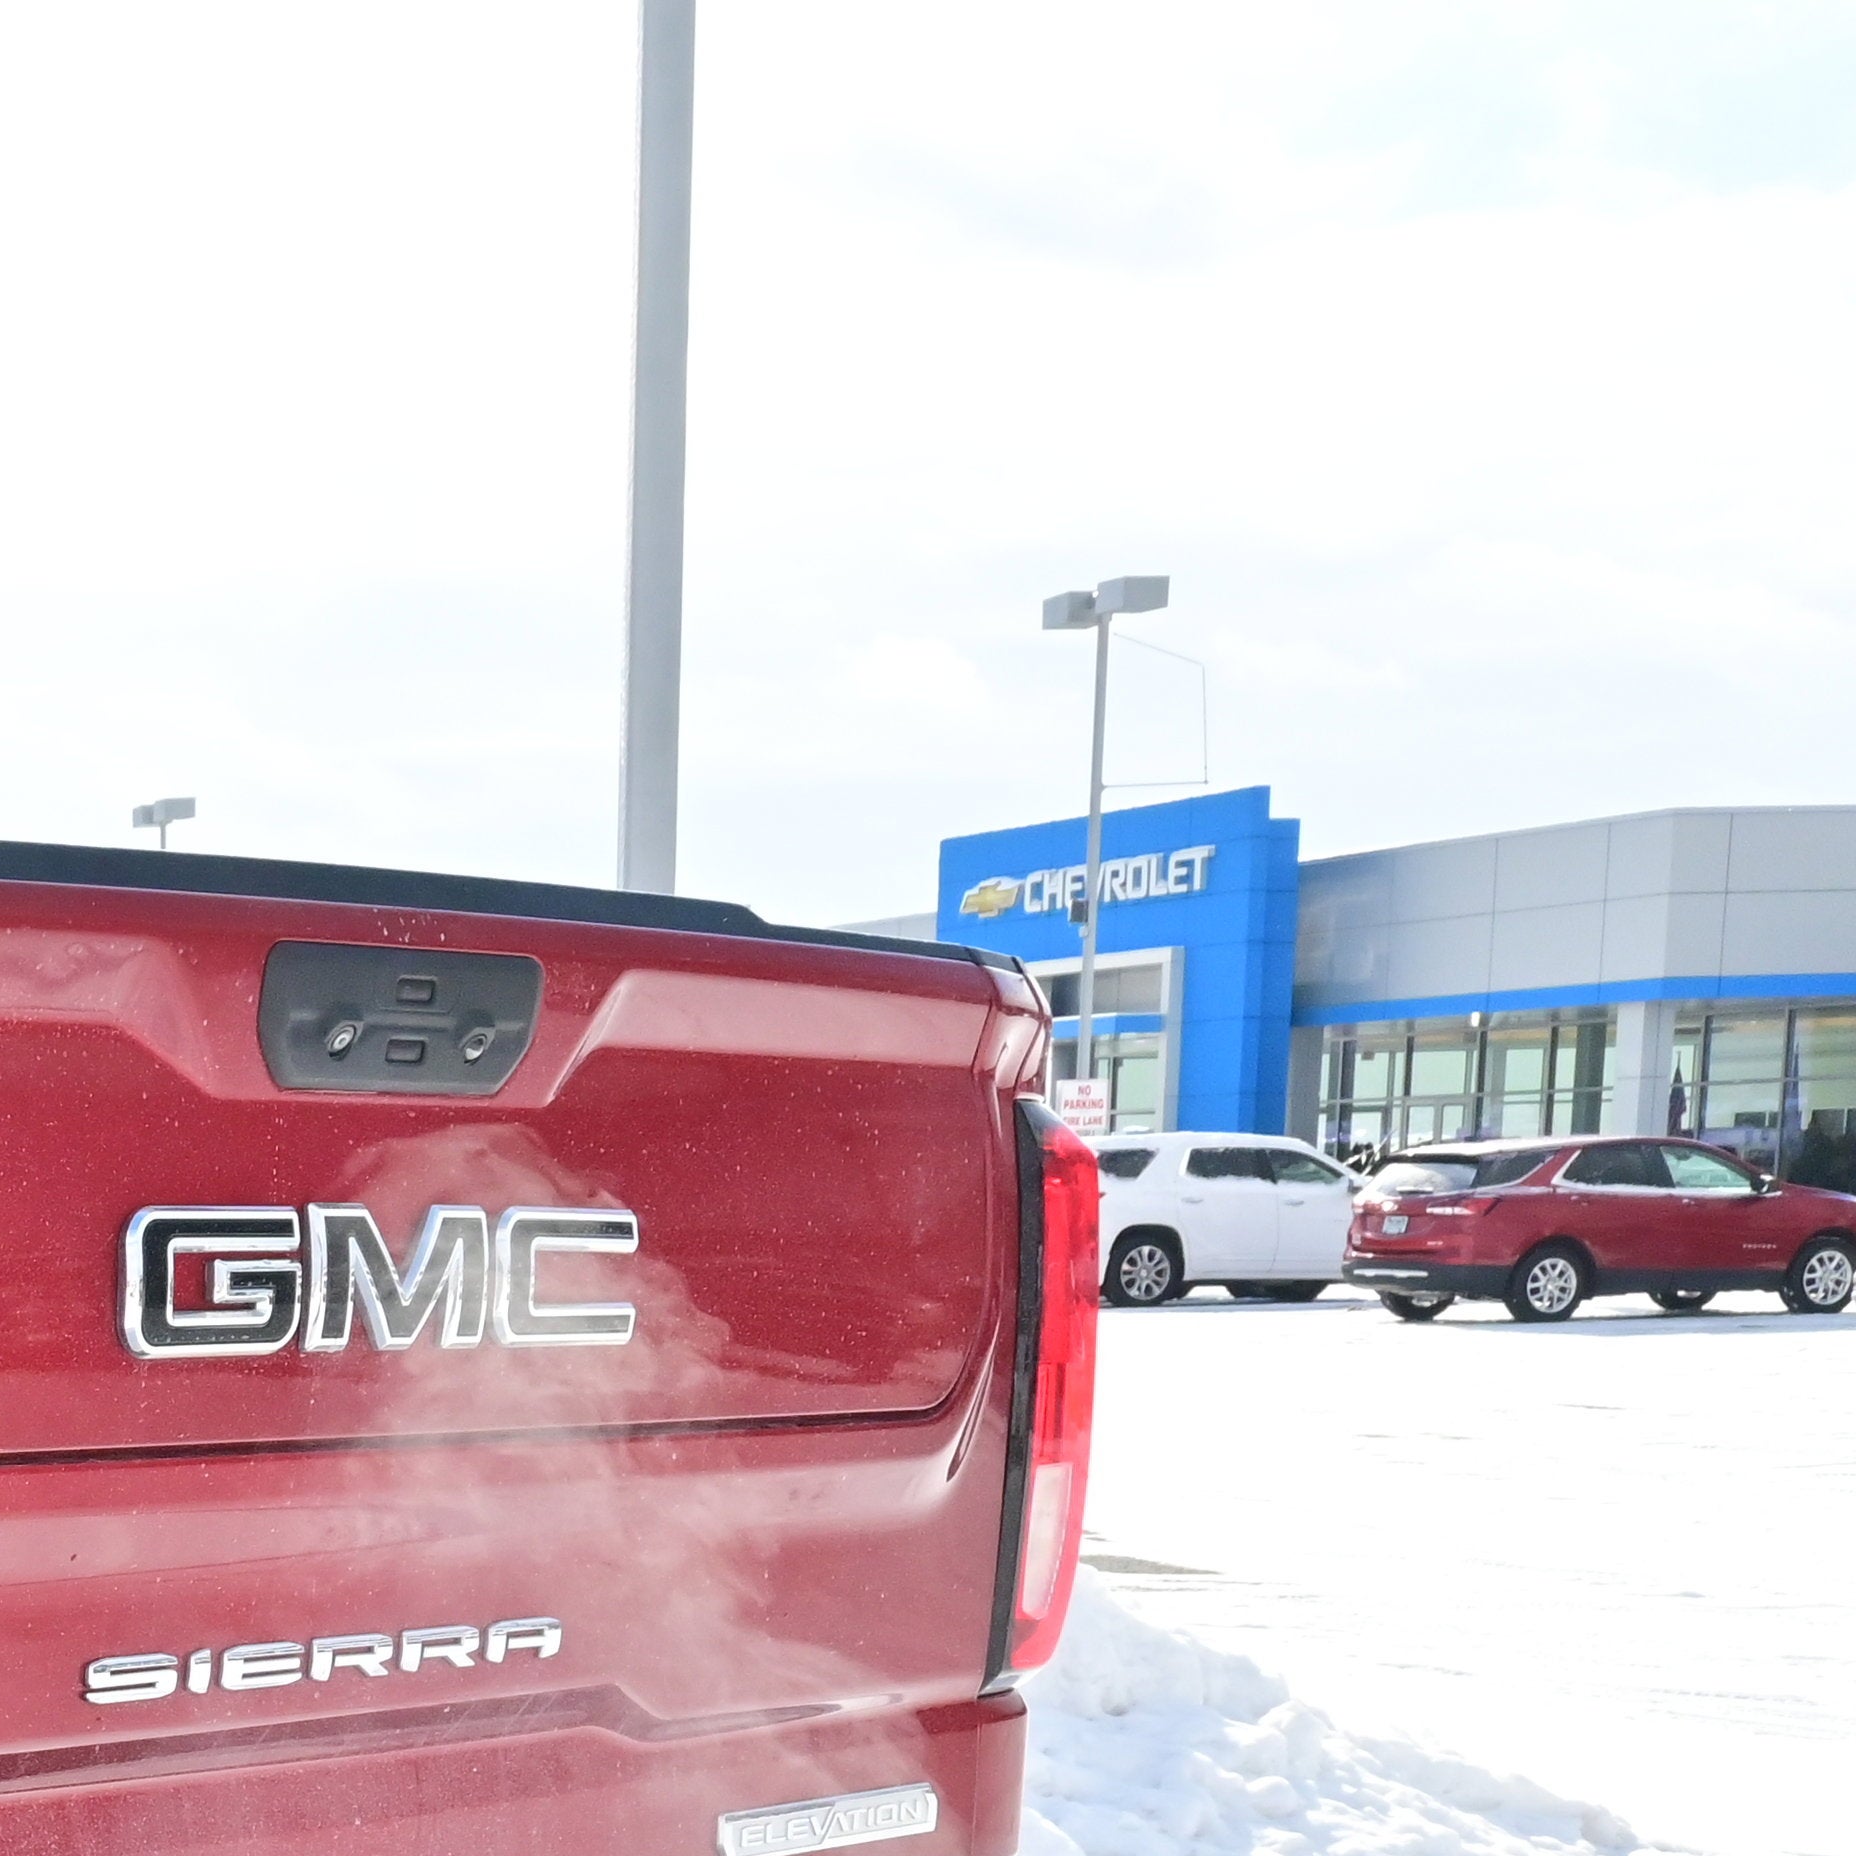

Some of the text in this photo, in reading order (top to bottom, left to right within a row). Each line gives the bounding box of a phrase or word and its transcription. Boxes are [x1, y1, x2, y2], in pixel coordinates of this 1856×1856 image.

[1064, 1099, 1104, 1110] PARKING
[1078, 1085, 1092, 1095] NO
[1083, 1116, 1103, 1126] LANE
[119, 1202, 639, 1358] GMC
[83, 1616, 562, 1704] SIERRA
[740, 1799, 921, 1849] ELEVATION
